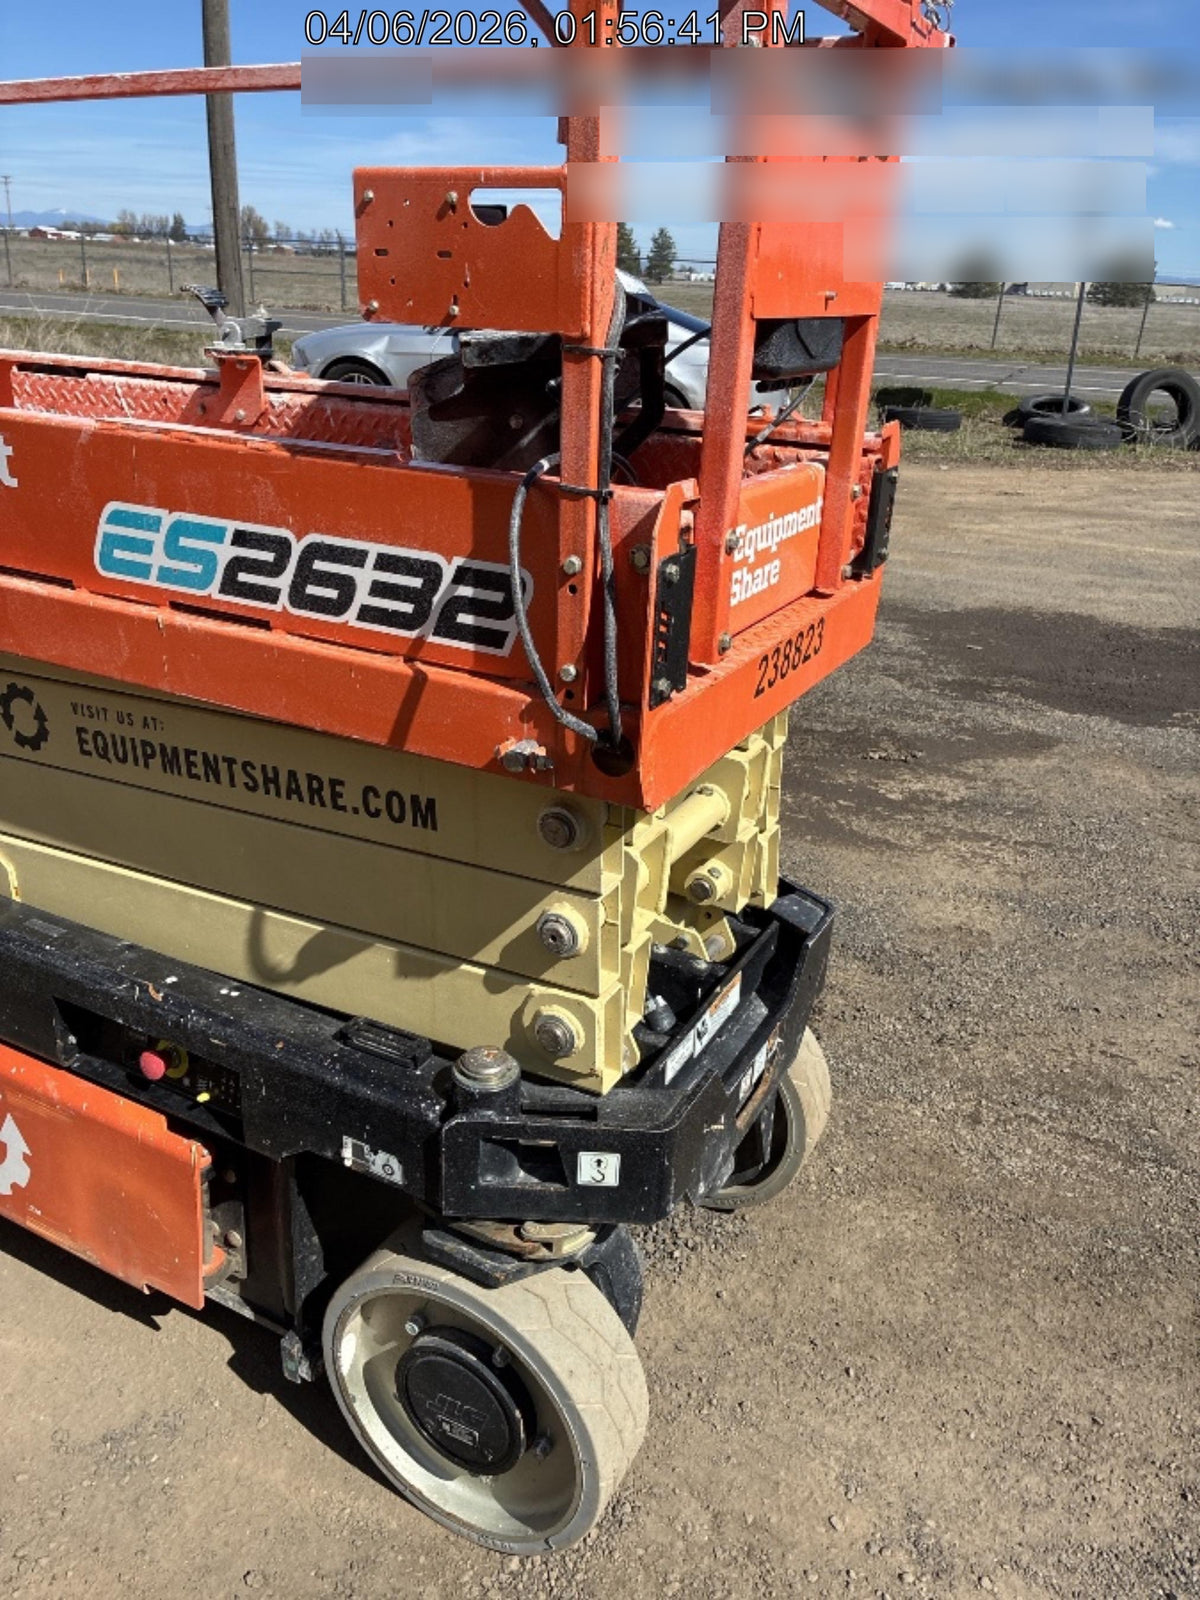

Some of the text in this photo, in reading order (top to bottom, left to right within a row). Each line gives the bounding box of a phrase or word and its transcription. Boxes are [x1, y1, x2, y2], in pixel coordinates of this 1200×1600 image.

[733, 495, 824, 564] Equipment
[96, 505, 531, 653] ES2632
[730, 559, 781, 607] Share
[753, 616, 825, 699] 238823
[70, 702, 165, 731] VISIT US AT:
[75, 726, 439, 832] EQUIPMENTSHARE.COM
